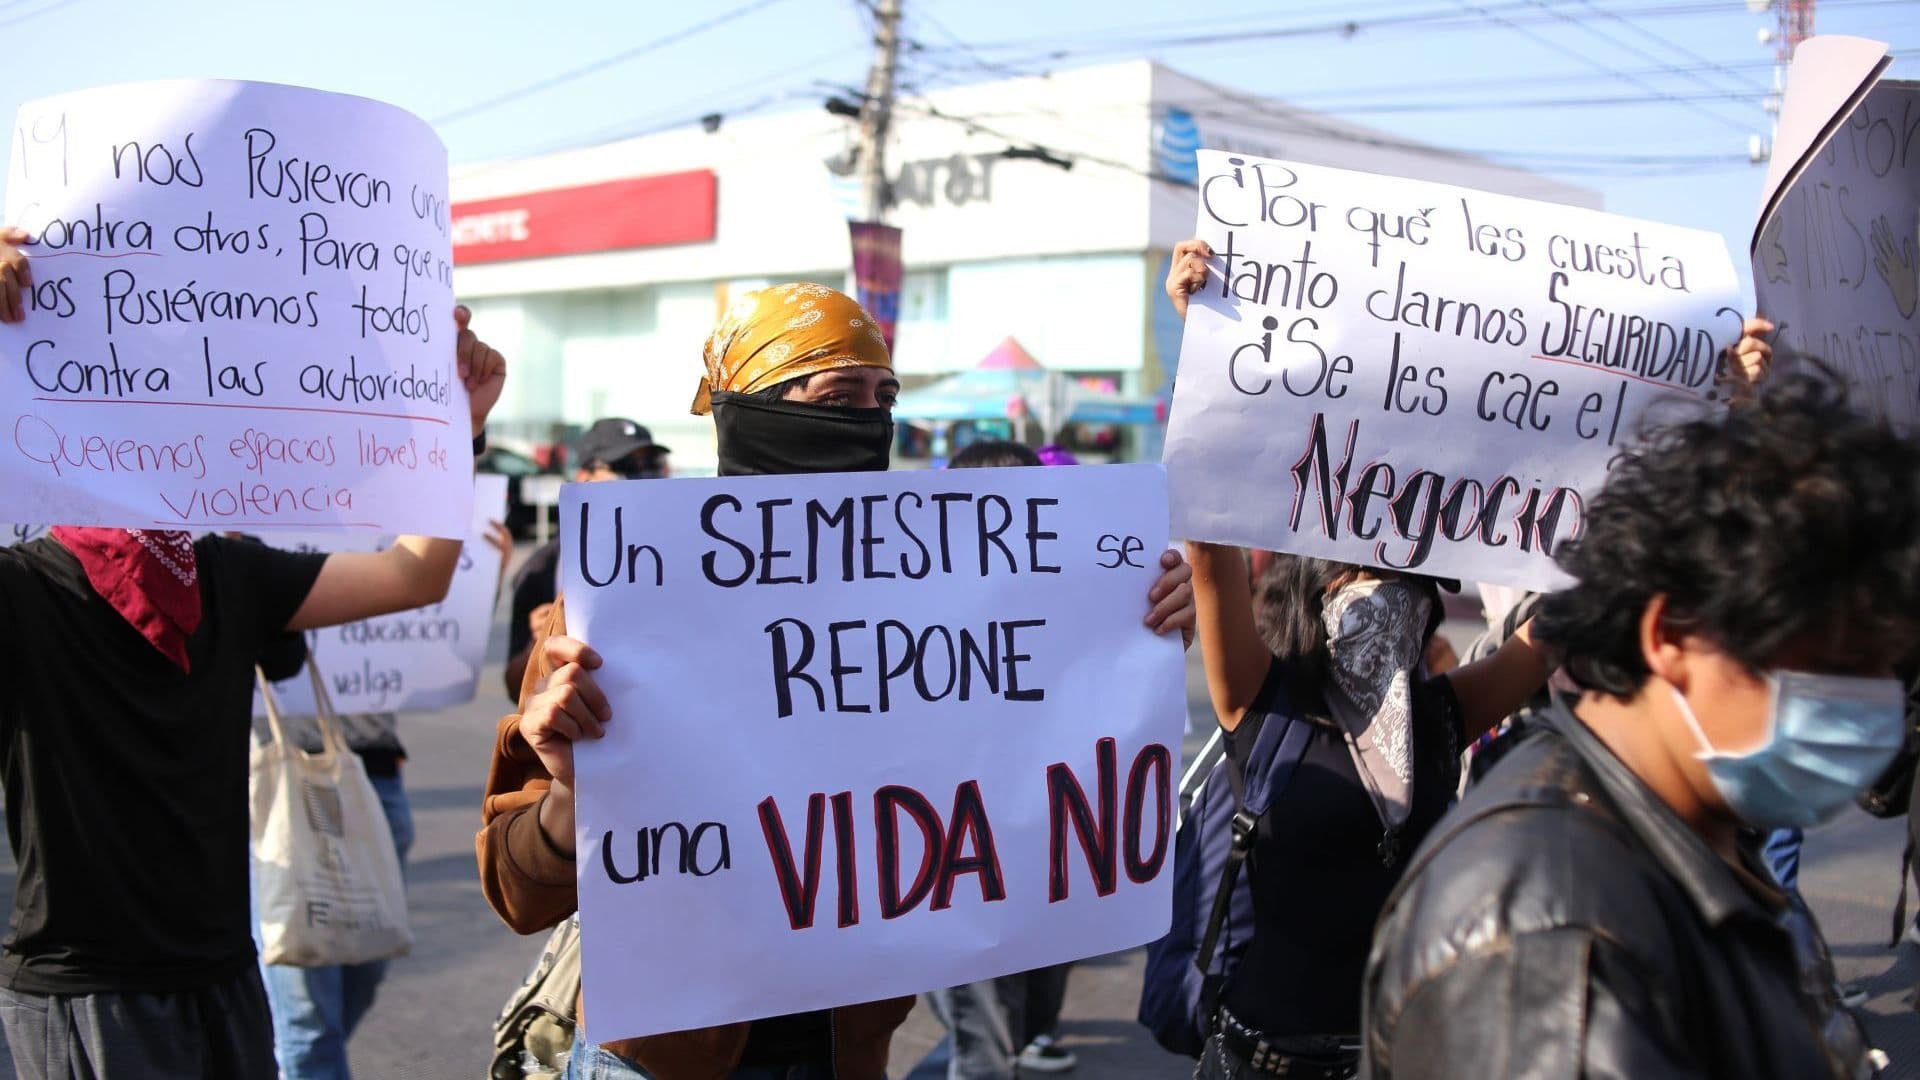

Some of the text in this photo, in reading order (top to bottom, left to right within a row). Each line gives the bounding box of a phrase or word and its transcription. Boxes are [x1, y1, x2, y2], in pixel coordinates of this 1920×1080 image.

[112, 132, 204, 187] nos
[174, 211, 283, 257] otros,
[299, 213, 380, 275] Para
[394, 244, 432, 300] que
[1202, 157, 1691, 293] ¿Por qué les cuesta
[352, 285, 430, 342] todos
[1209, 231, 1339, 311] tanto
[1365, 261, 1527, 347] darnos
[25, 339, 170, 397] Contra
[203, 336, 268, 397] las
[1229, 315, 1628, 447] ¿Se les cae el
[14, 414, 449, 479] Queremos espacios libres de
[160, 481, 352, 520] violencia
[580, 491, 1145, 588] Un SEMESTRE se
[764, 617, 1047, 718] REPONE
[602, 736, 1173, 930] una VIDA NO
